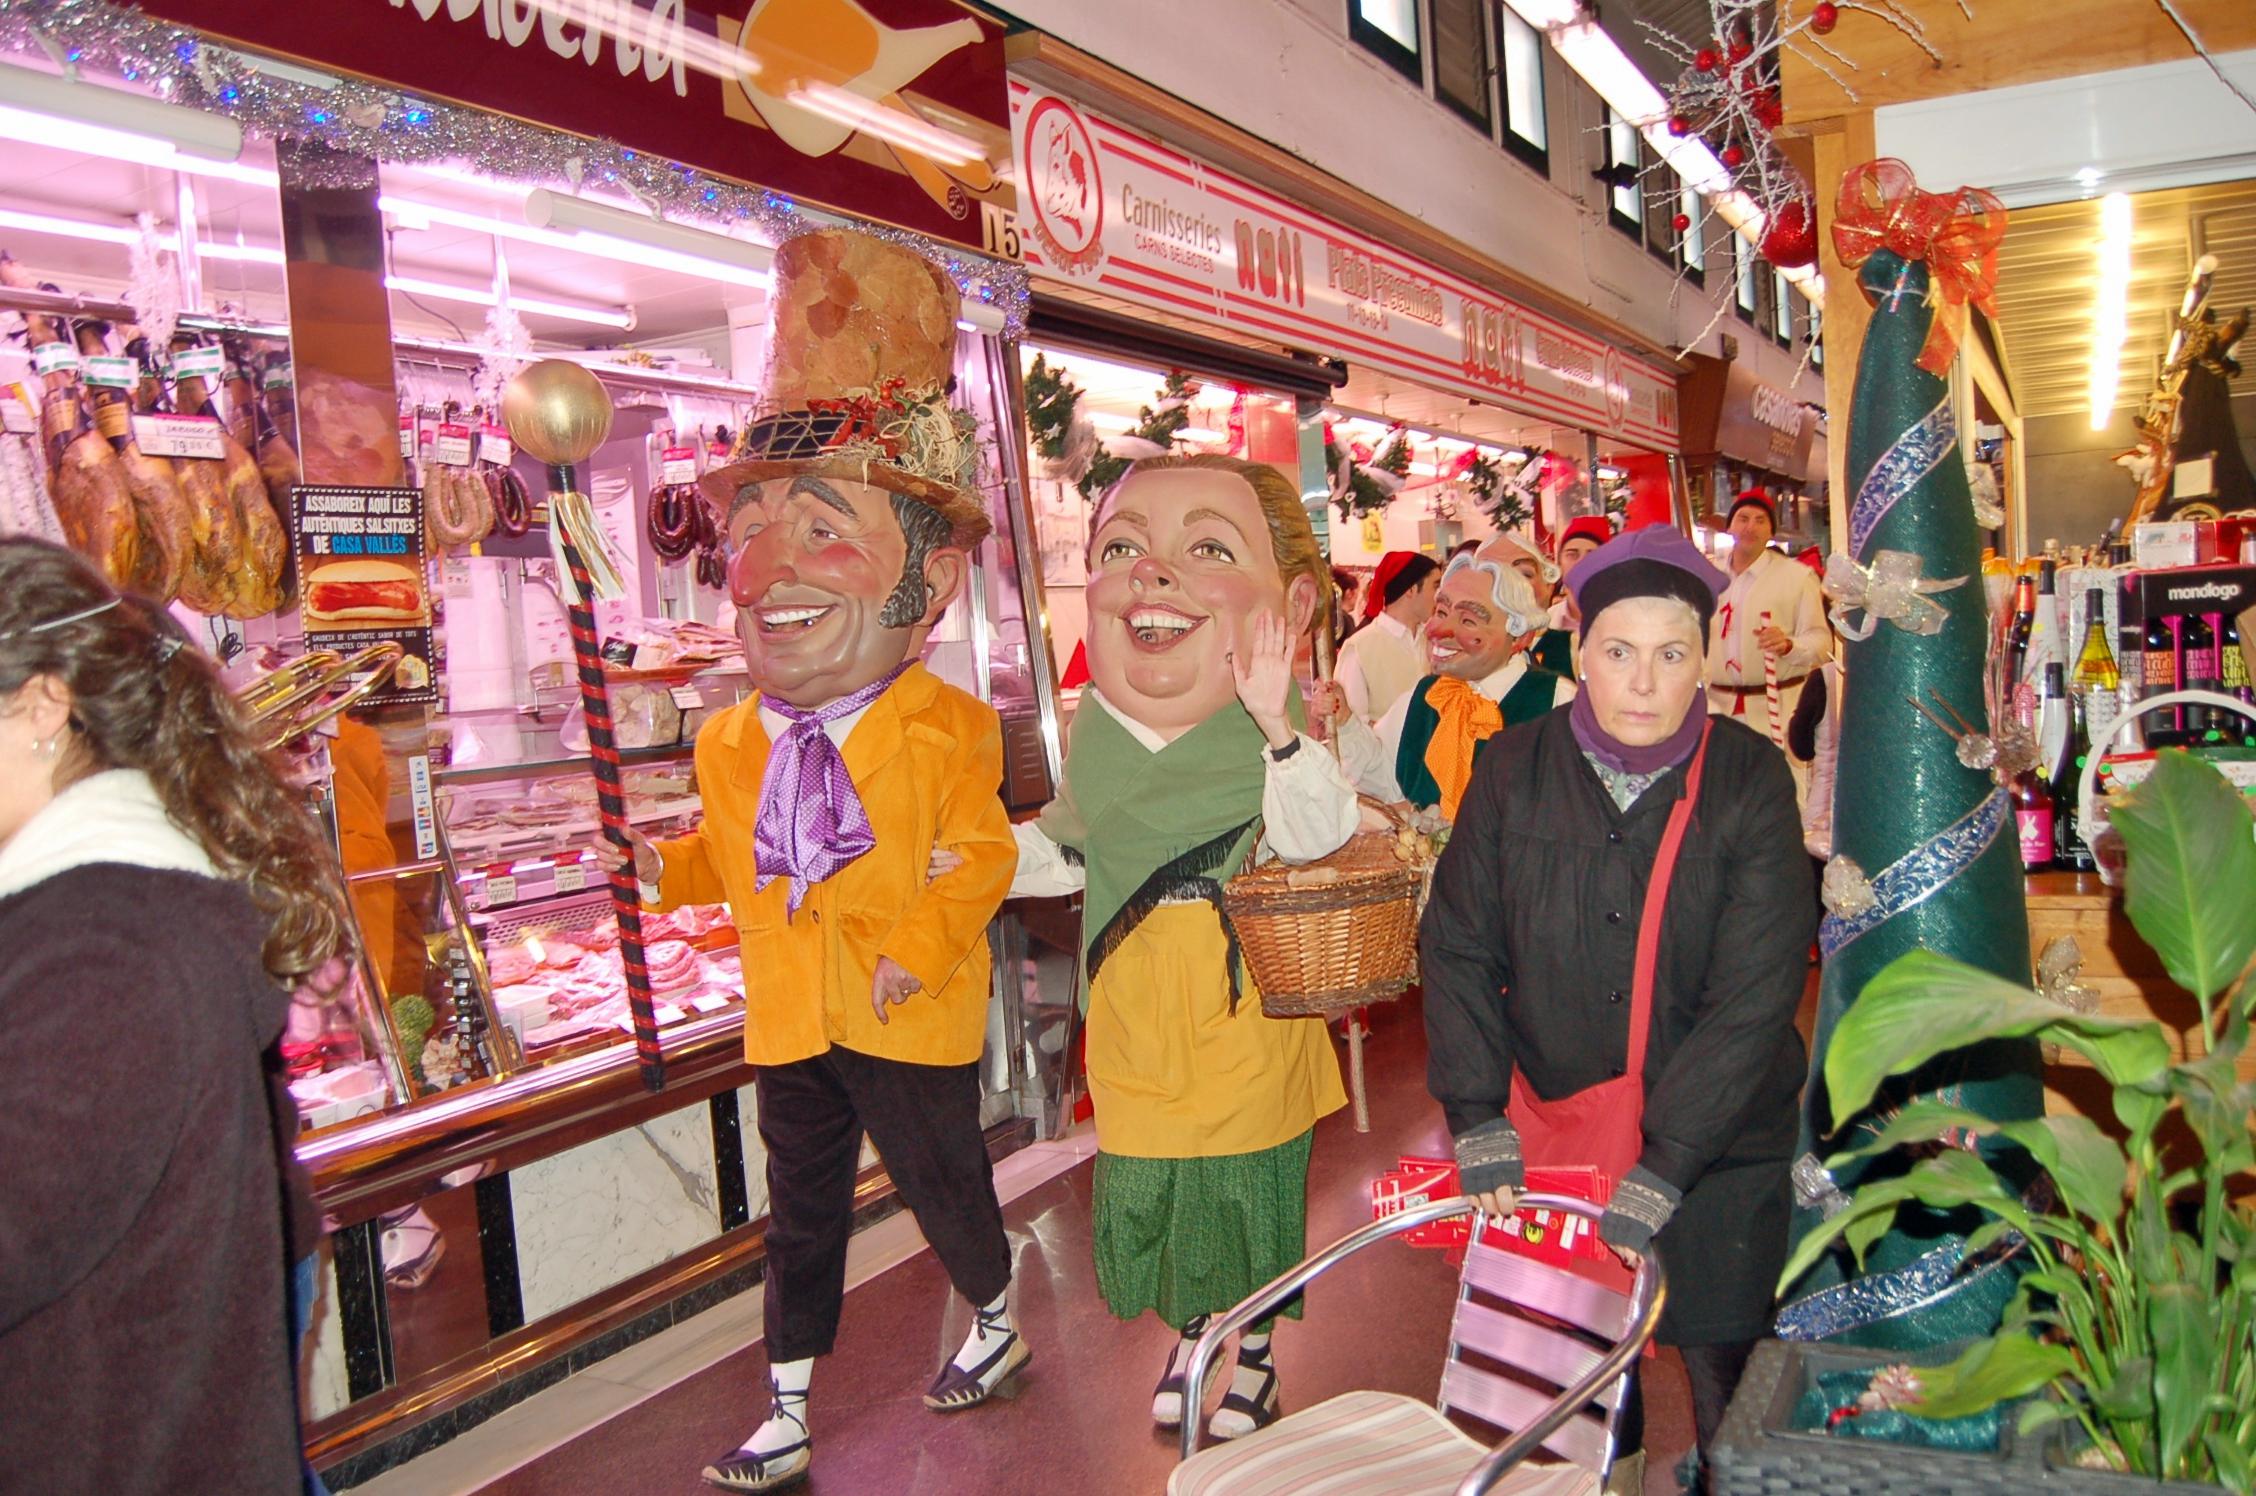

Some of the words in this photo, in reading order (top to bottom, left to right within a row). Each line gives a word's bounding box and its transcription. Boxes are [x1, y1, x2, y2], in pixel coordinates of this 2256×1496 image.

[987, 208, 1020, 259] 15
[1122, 183, 1221, 254] Carnisseries
[1134, 232, 1170, 258] CARNS
[1171, 244, 1214, 274] SELECTES
[1233, 218, 1304, 309] nati
[305, 495, 365, 512] ASSABOREIX
[368, 494, 390, 514] AQUÍ
[392, 498, 411, 514] LES
[312, 535, 330, 554] DE
[332, 535, 362, 554] CASA
[366, 517, 416, 534] SALSITXES
